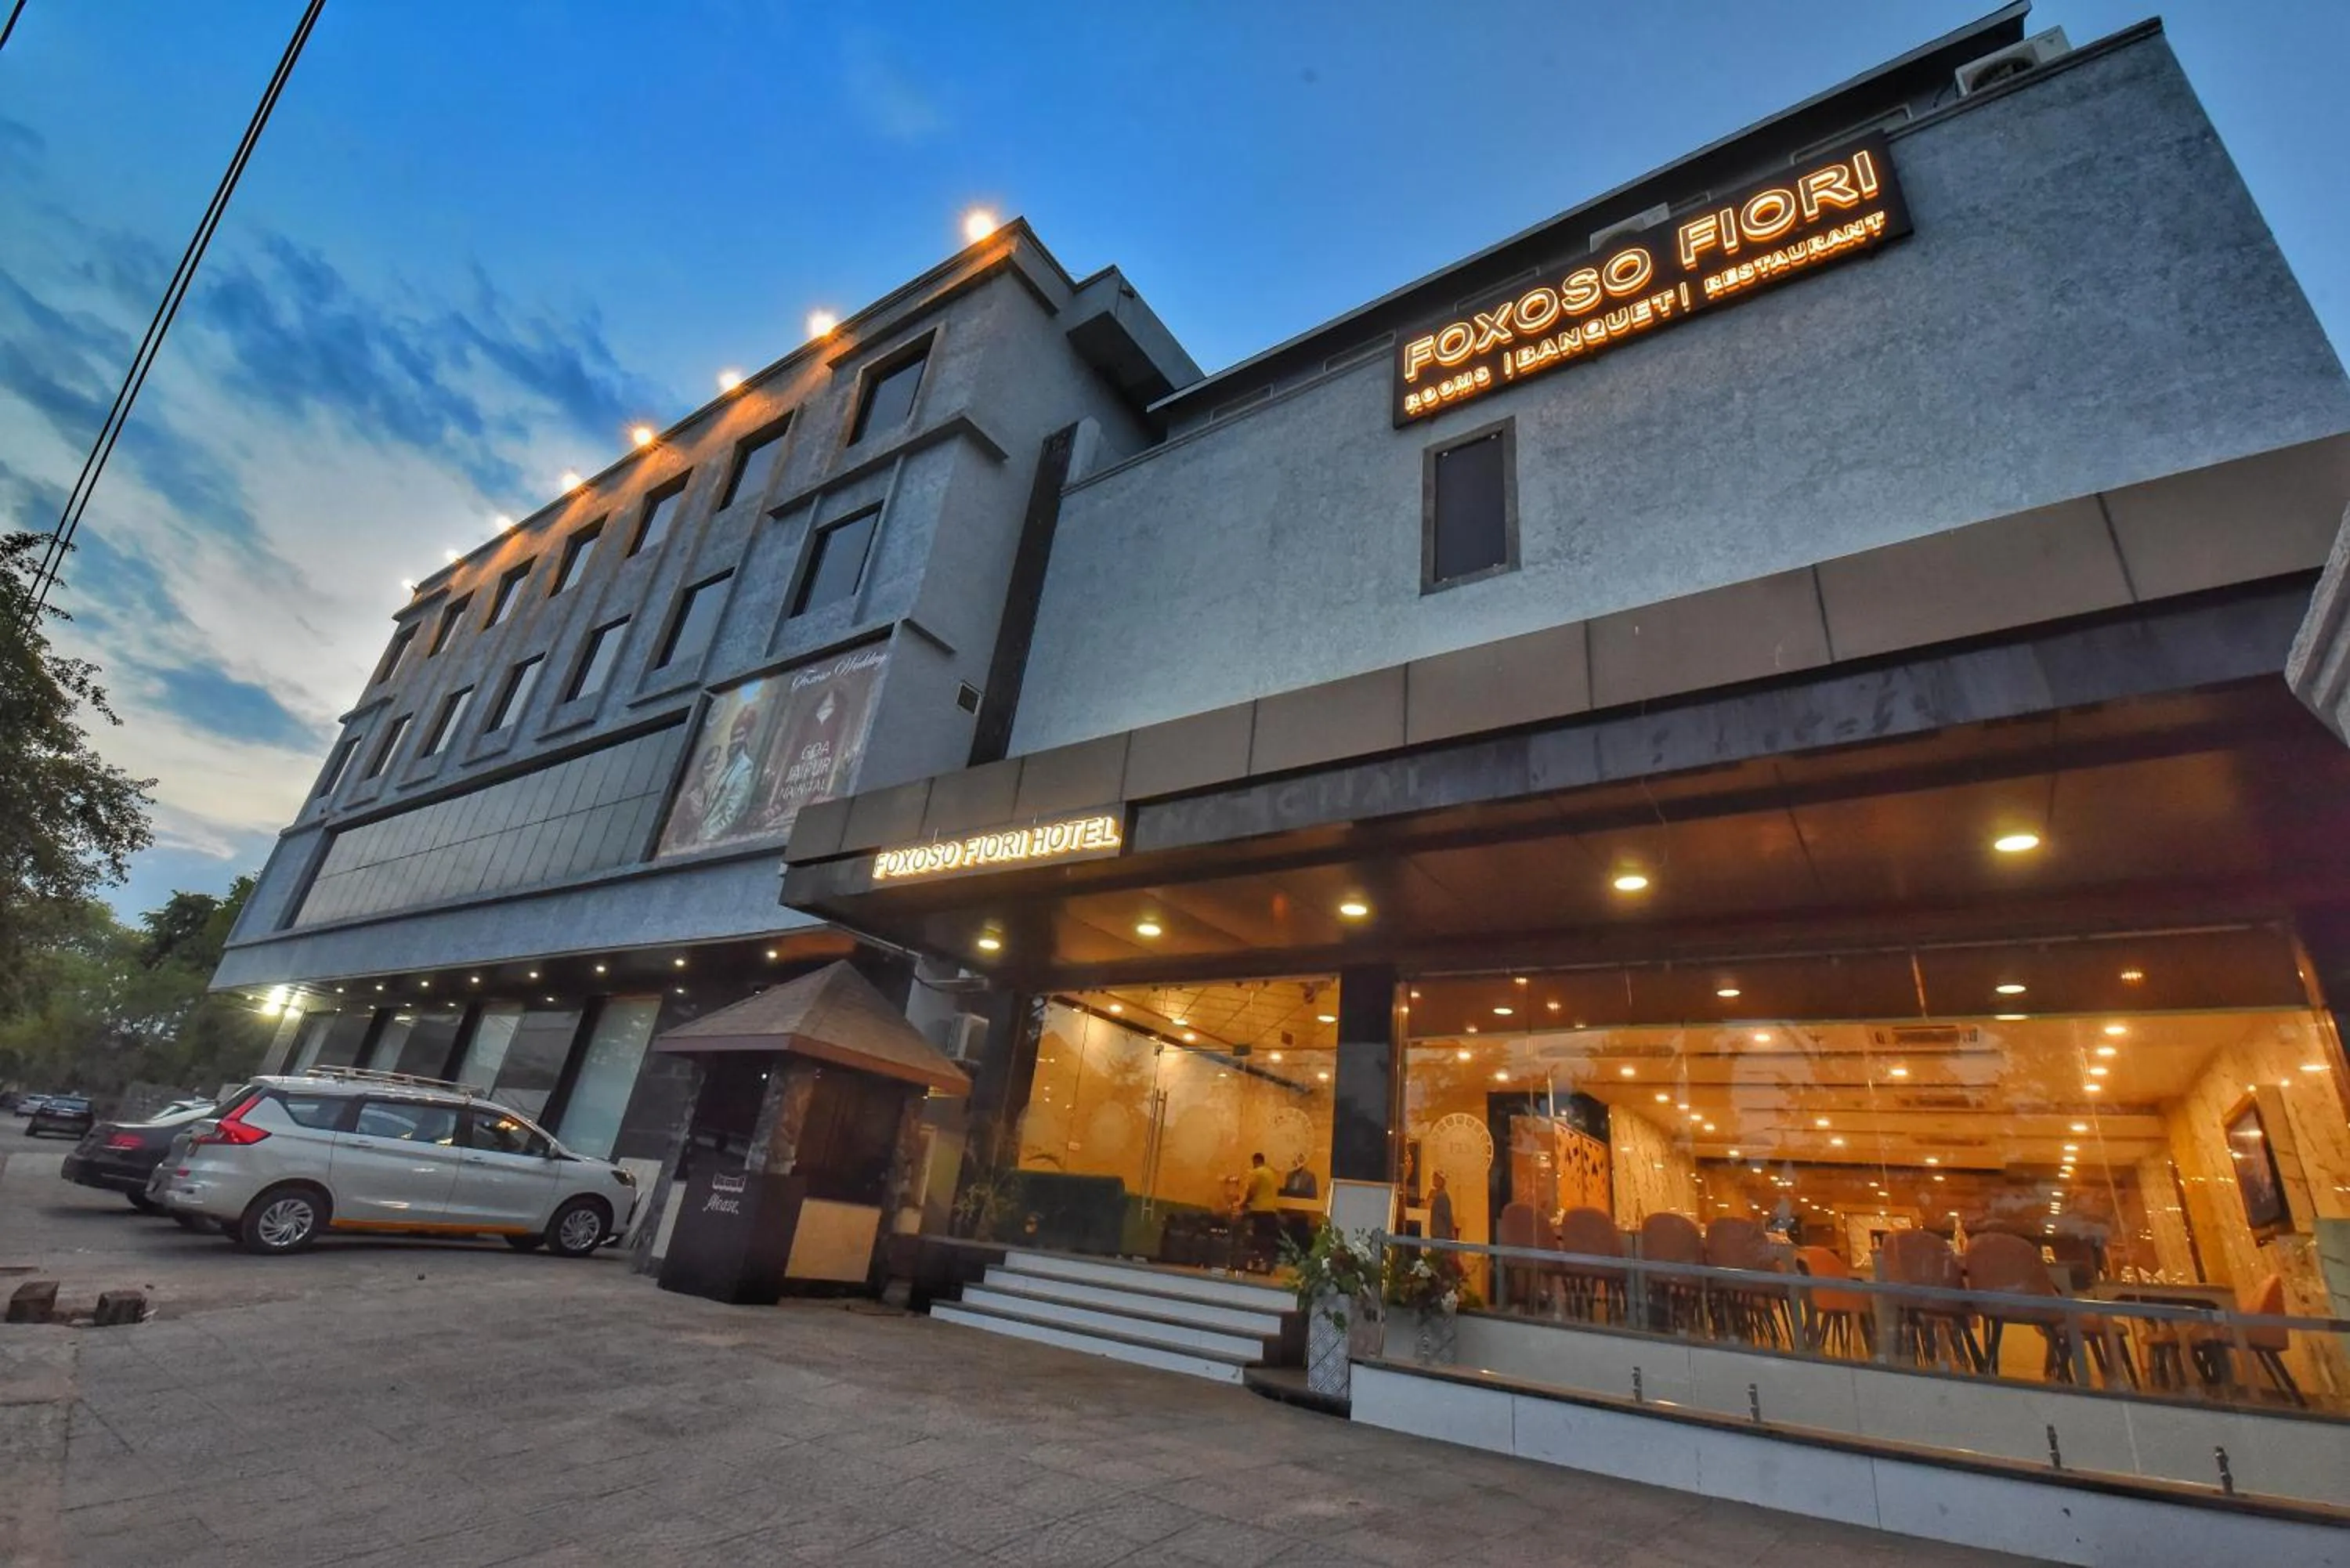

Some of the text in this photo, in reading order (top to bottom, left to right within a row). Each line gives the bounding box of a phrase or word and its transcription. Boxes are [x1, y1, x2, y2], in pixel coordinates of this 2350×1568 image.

[1405, 150, 1878, 382] FOXOSO FIORI
[1405, 366, 1491, 414] ROOMS
[1704, 211, 1886, 300] RESTAURANT
[872, 816, 1120, 879] FOXOSO FIORI HOTEL
